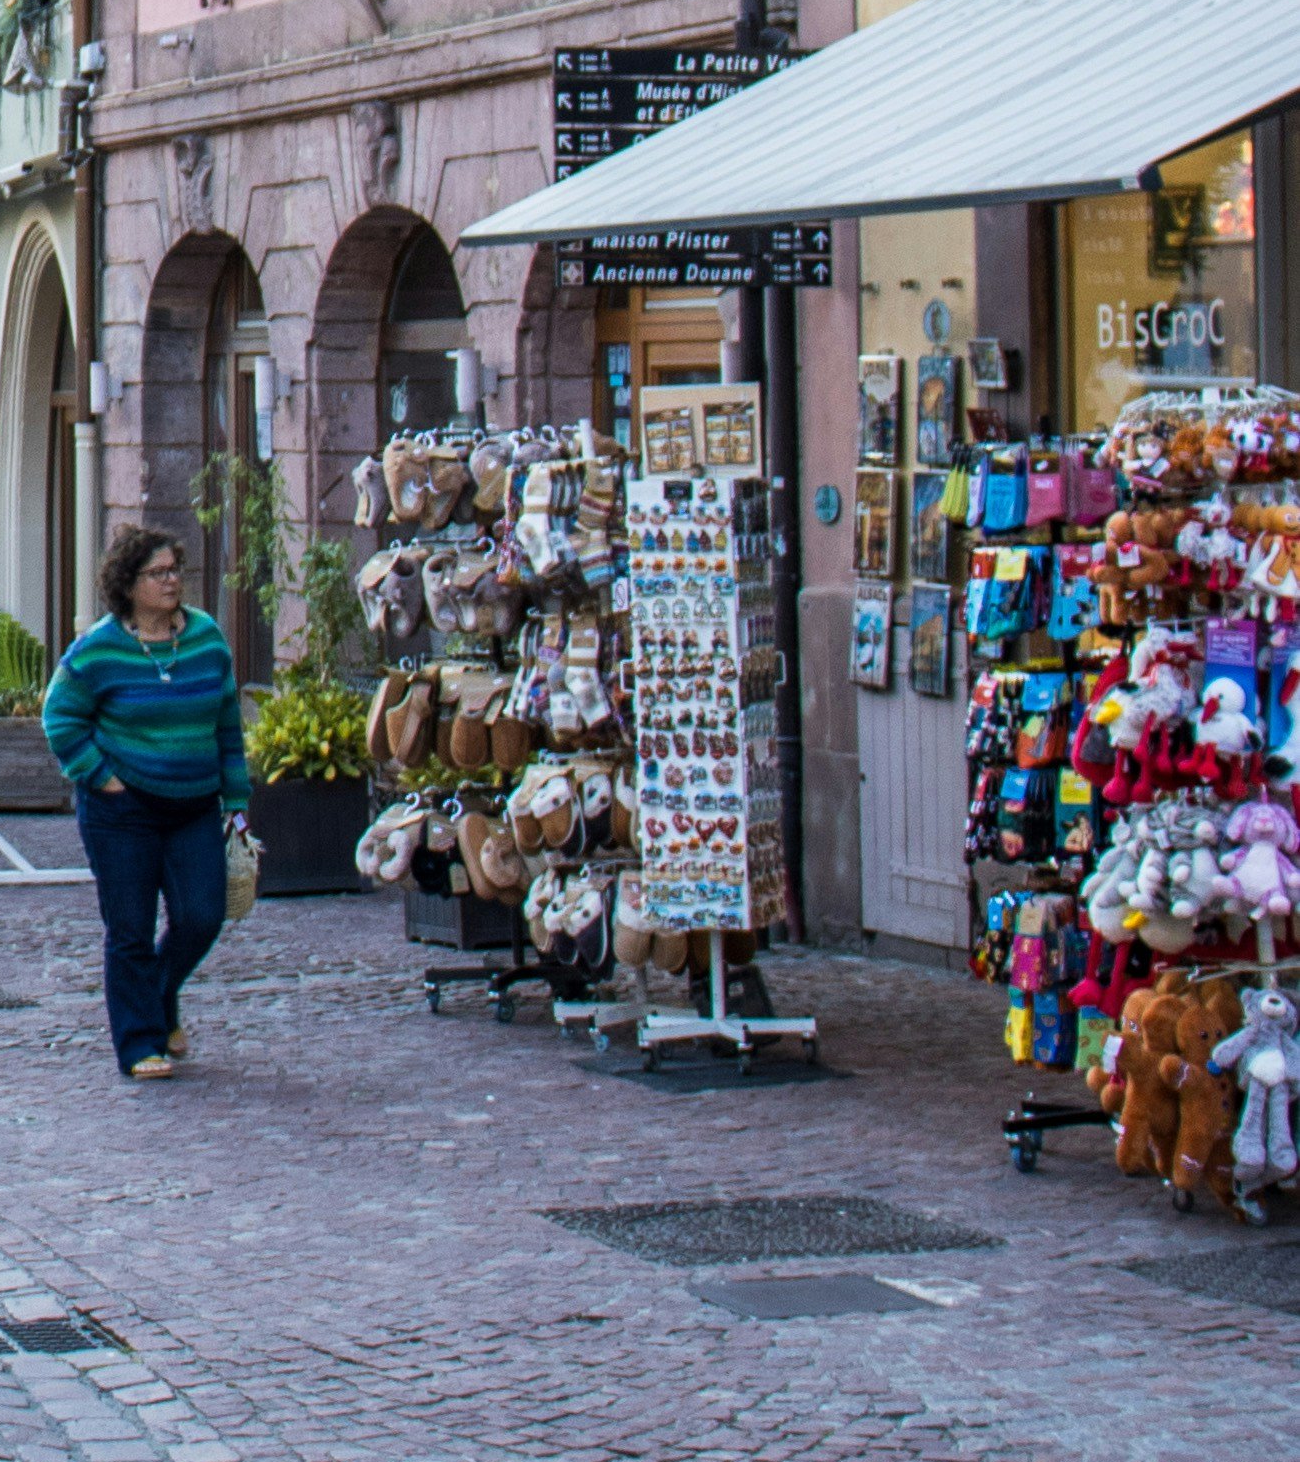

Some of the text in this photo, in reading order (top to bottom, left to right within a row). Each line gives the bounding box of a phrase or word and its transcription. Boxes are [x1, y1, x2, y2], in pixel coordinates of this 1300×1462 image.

[674, 53, 696, 72] La
[703, 53, 760, 73] Petite
[637, 81, 692, 100] Musée
[637, 105, 655, 121] et
[666, 230, 730, 250] Pfister
[592, 263, 678, 283] Ancienne
[685, 262, 753, 284] Douane
[1097, 298, 1226, 349] BisCroC
